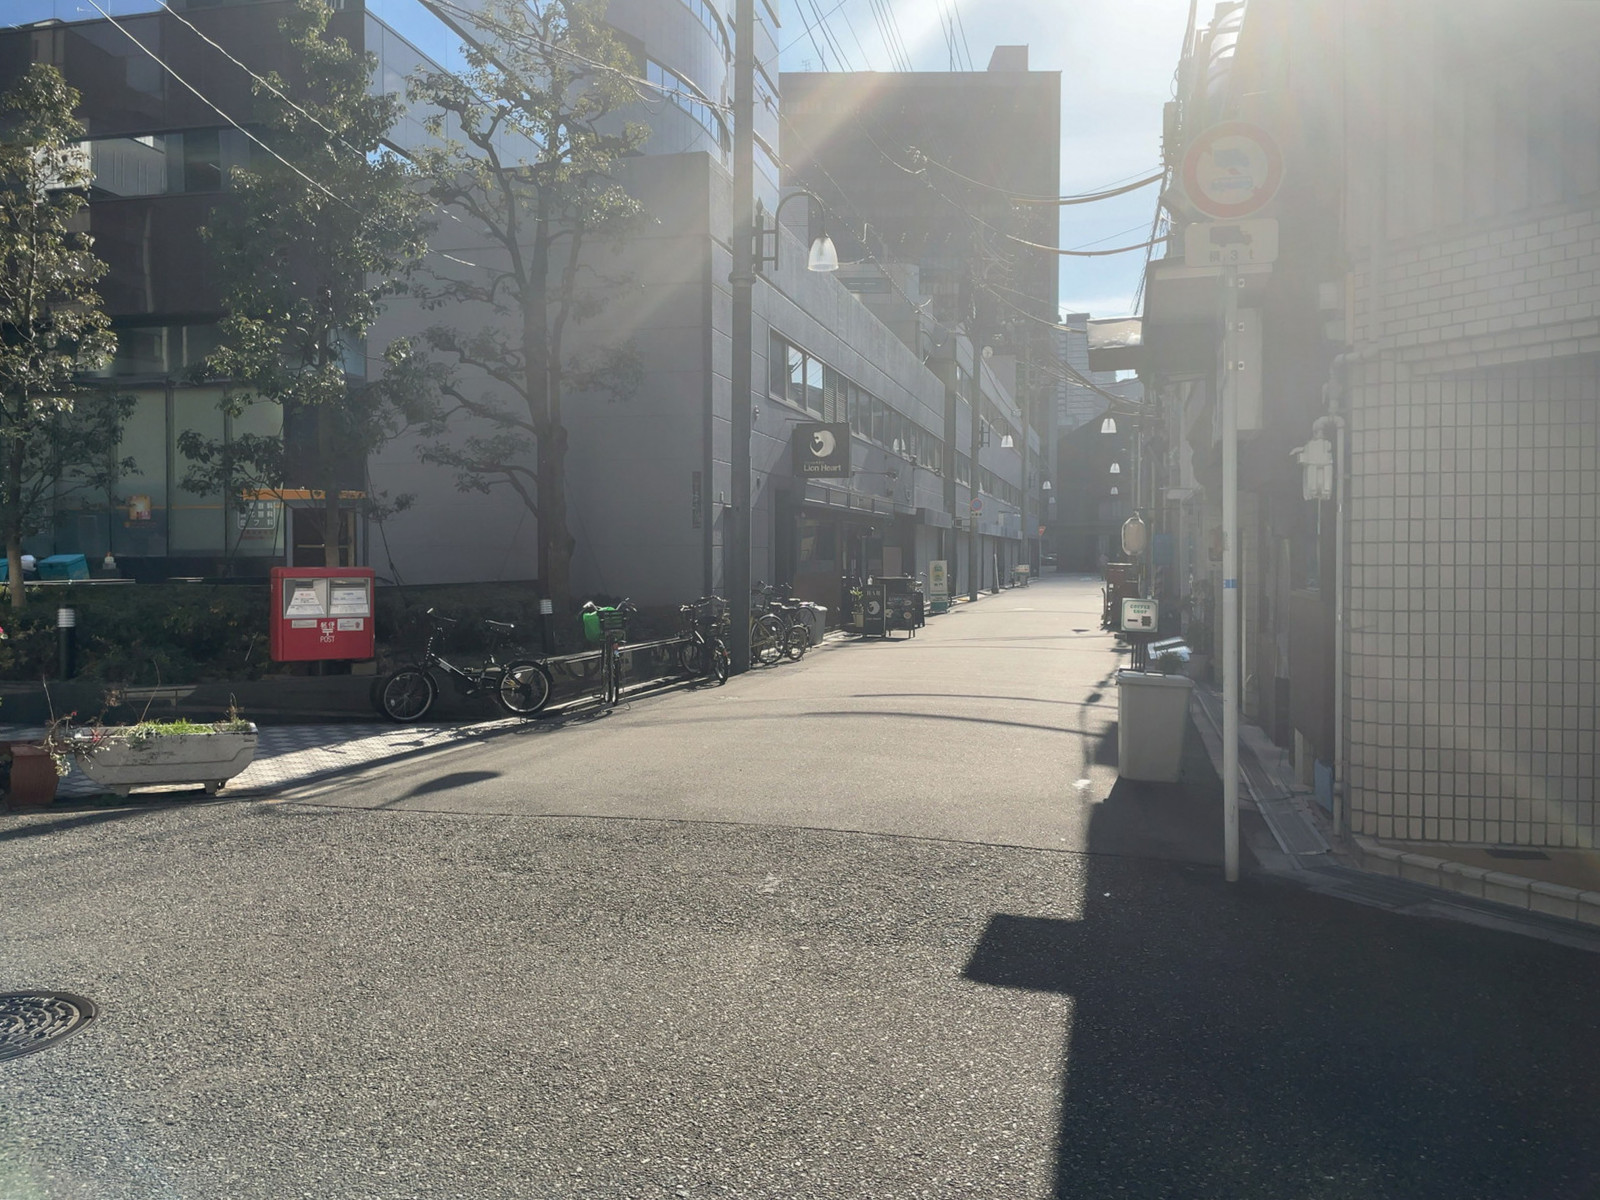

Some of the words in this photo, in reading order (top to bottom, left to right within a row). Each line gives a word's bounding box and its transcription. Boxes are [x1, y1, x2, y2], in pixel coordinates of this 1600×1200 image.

[803, 464, 820, 472] Lion
[820, 464, 842, 472] Heart
[1127, 615, 1152, 627] 一番
[319, 635, 336, 643] POST
